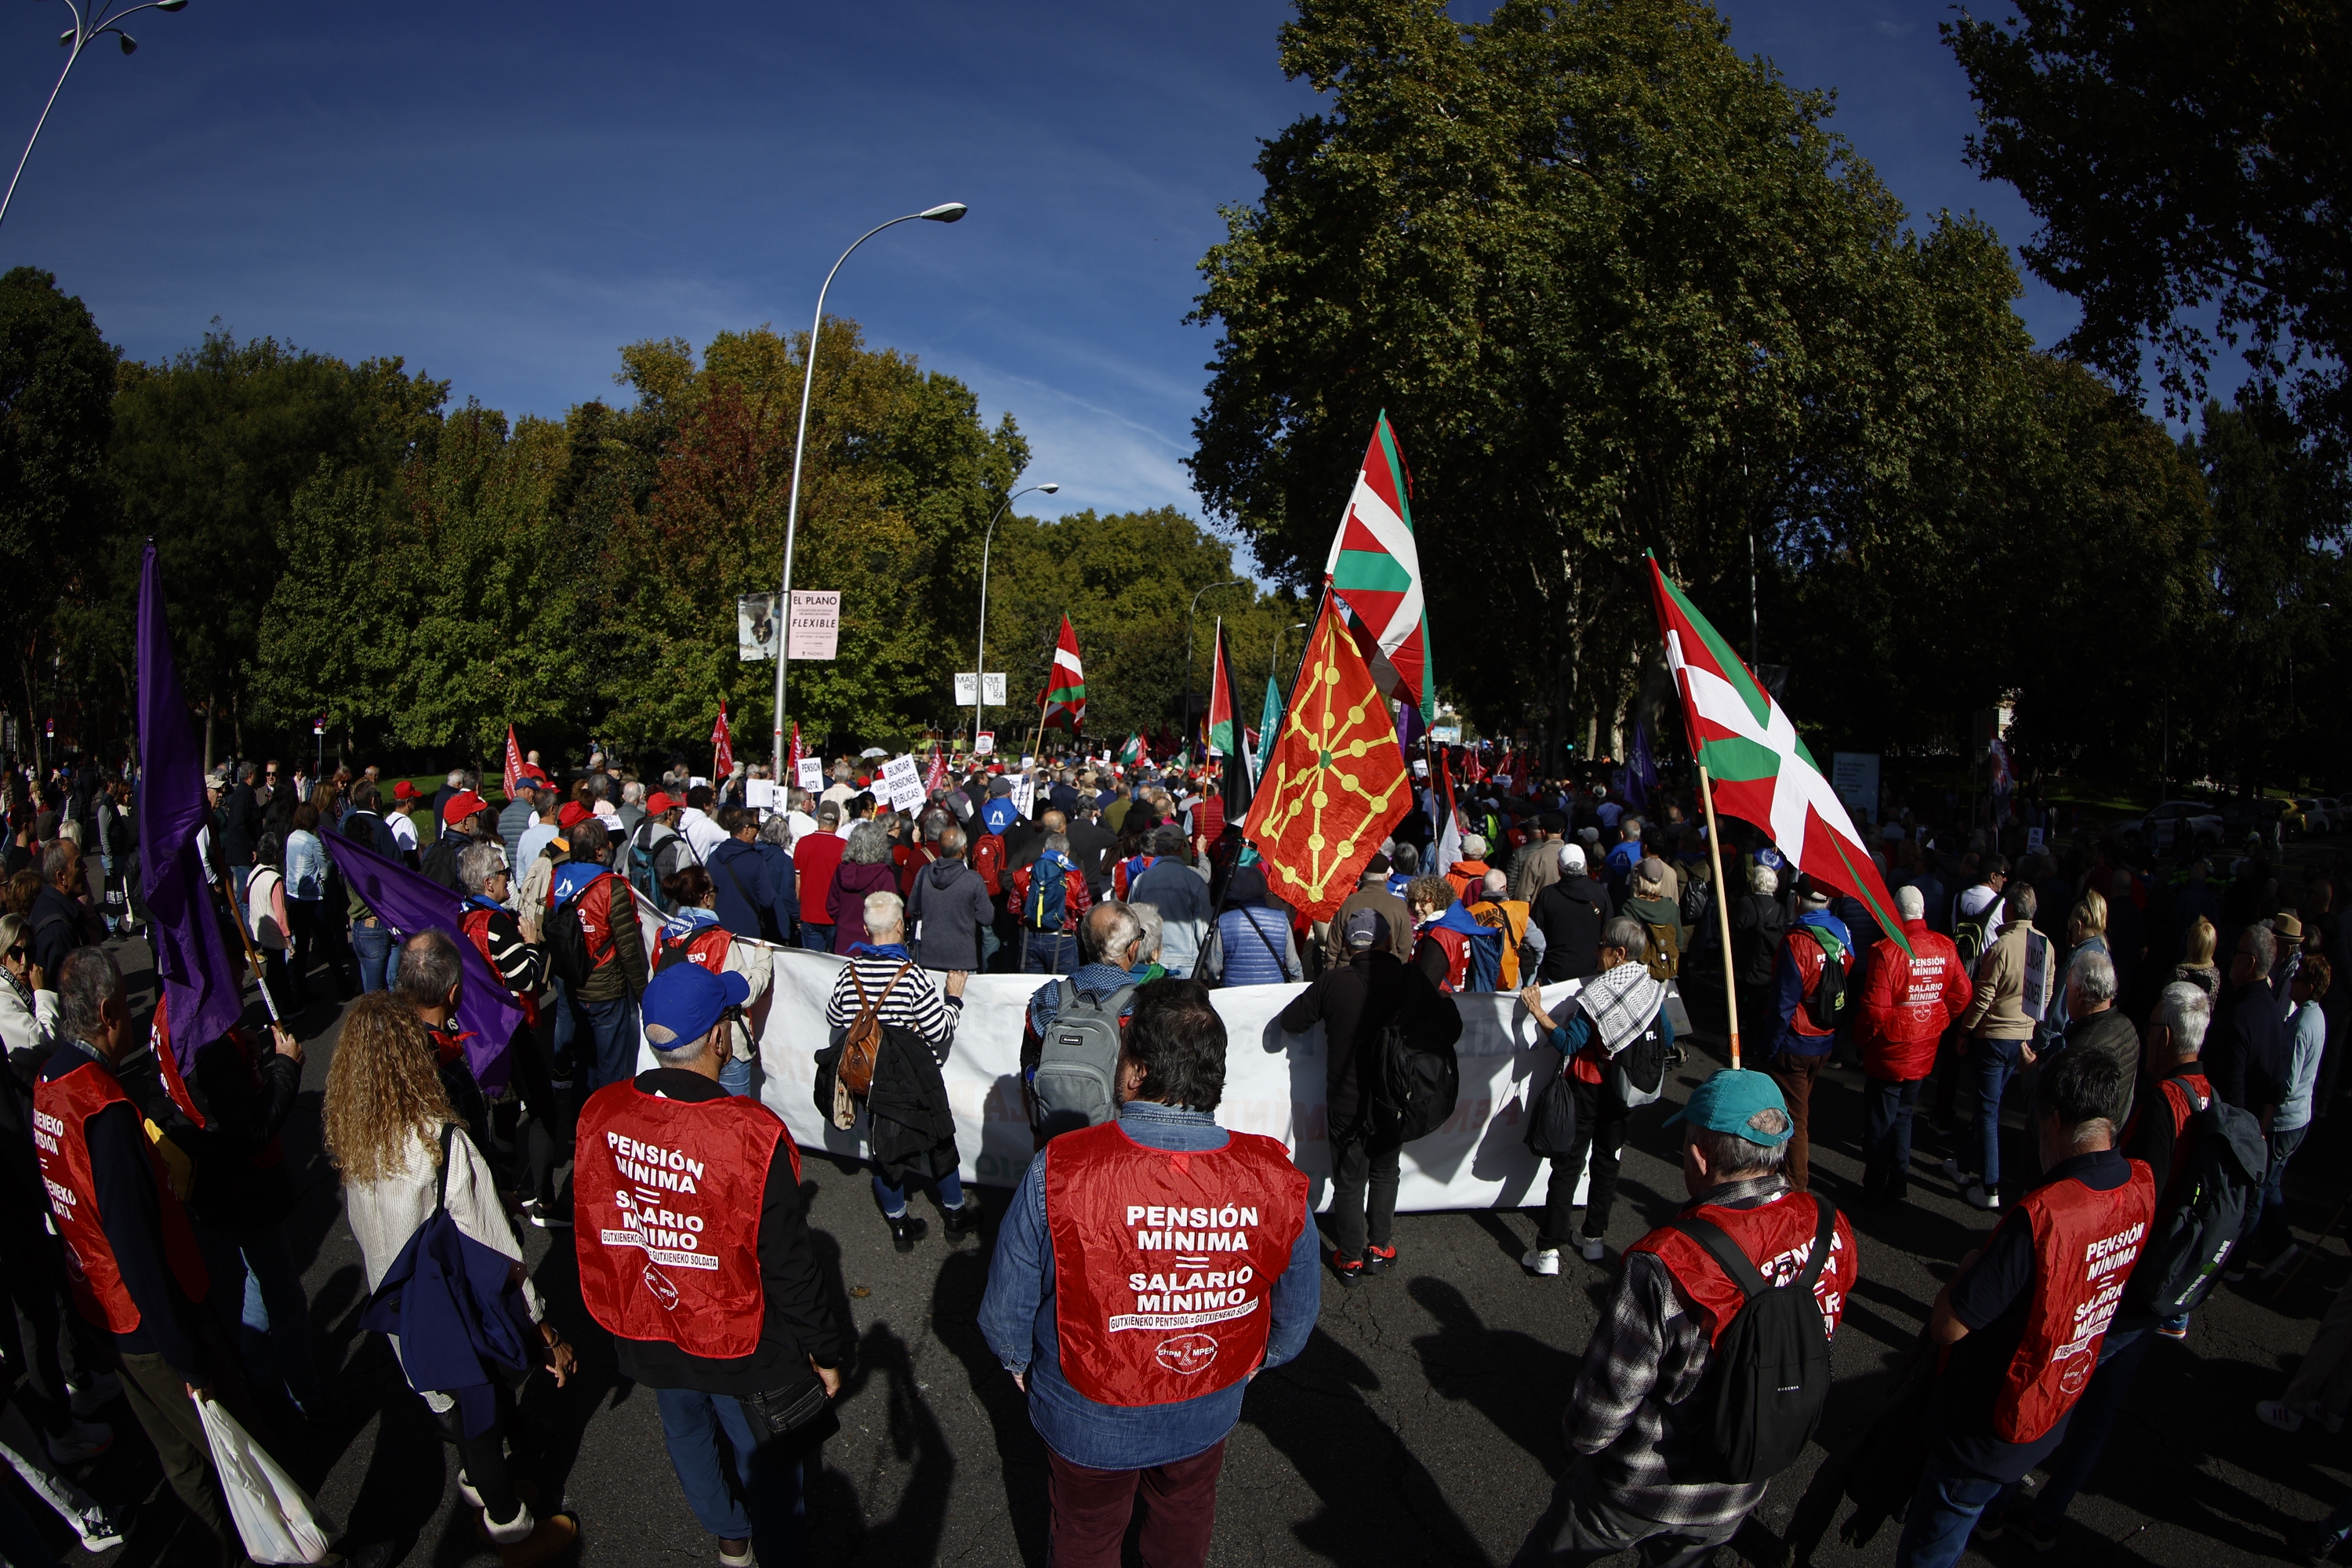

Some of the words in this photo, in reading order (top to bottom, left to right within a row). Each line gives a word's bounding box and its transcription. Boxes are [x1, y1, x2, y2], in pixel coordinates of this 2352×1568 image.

[793, 596, 802, 605] EL
[806, 596, 837, 605] PLANO
[792, 619, 837, 628] FLEXIBLE
[983, 676, 1001, 684] CUL
[801, 760, 821, 774] PENSIÓN
[887, 760, 912, 780] ¡BLINDAR
[804, 781, 819, 791] JUSTA!
[888, 773, 917, 793] PENSIONES
[893, 787, 921, 806] PÚBLICAS!
[1908, 956, 1946, 967] PENSIÓN
[1912, 965, 1944, 976] MÍNIMA
[1907, 982, 1944, 993] SALARIO
[1908, 991, 1940, 1001] MÍNIMO
[607, 1131, 705, 1181] PENSIÓN
[614, 1154, 697, 1195] MÍNIMA
[615, 1189, 705, 1233] SALARIO
[1127, 1203, 1258, 1229] PENSIÓN
[602, 1231, 638, 1243] GUTXIENEKO
[1137, 1227, 1249, 1252] MÍNIMA
[2085, 1221, 2146, 1262] PENSIÓN
[652, 1250, 689, 1265] GUTXIENEKO
[690, 1254, 717, 1268] SOLDATA
[2086, 1245, 2137, 1283] MÍNIMA
[1128, 1265, 1254, 1292] SALARIO
[1137, 1287, 1247, 1313] MÍNIMO
[1110, 1315, 1154, 1330] GUTXIENEKO
[1155, 1316, 1189, 1327] PENTSIOA
[1195, 1309, 1236, 1324] GUTXIENEKO
[1158, 1348, 1182, 1358] EHPM
[1192, 1345, 1214, 1357] MPEH
